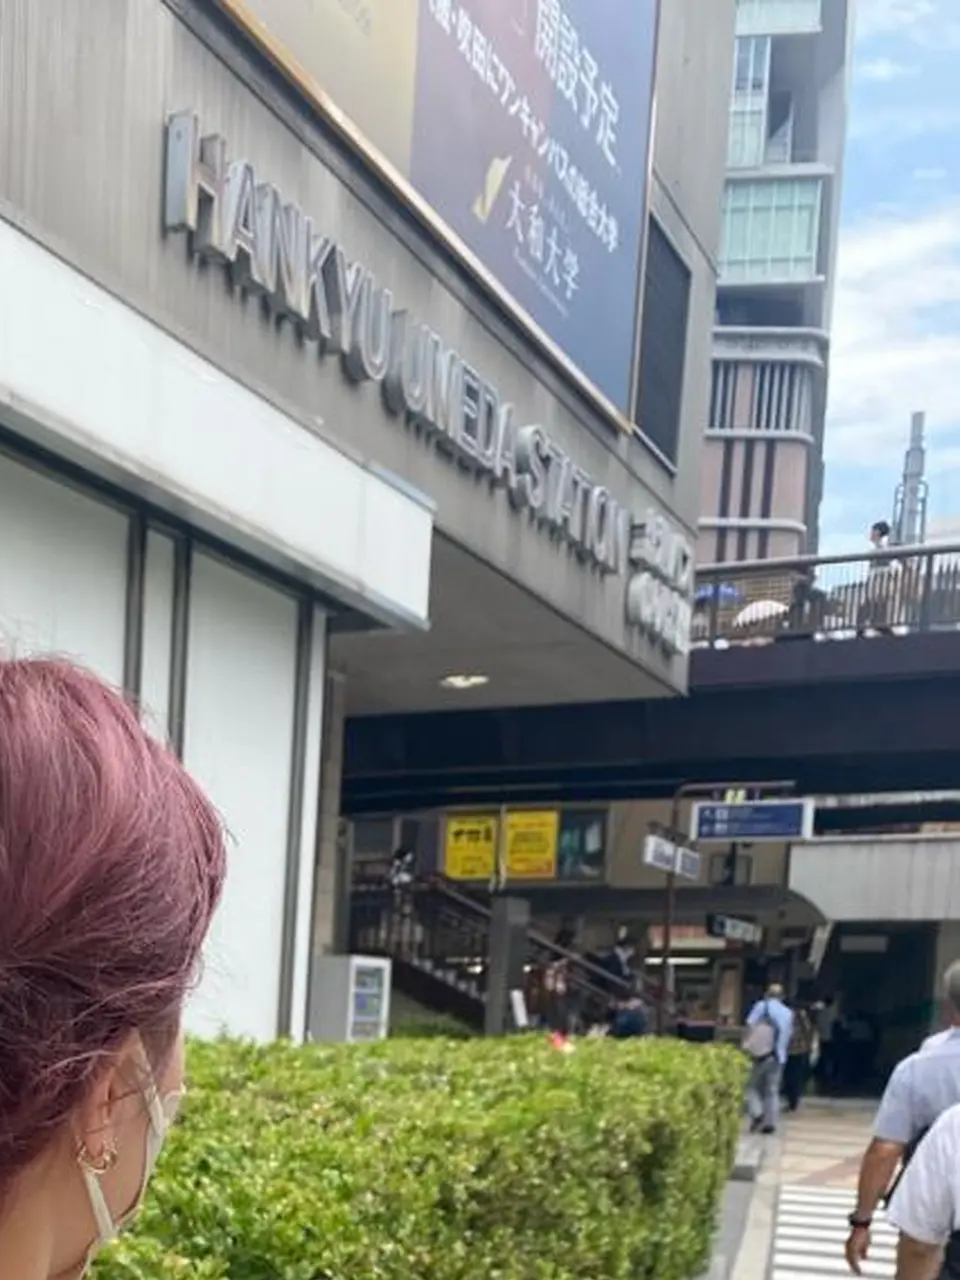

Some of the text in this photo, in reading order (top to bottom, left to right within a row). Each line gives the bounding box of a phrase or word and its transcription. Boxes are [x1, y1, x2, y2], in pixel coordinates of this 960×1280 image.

[164, 111, 393, 381] HANKYU
[384, 308, 519, 488] UMEDA
[513, 423, 630, 577] STATION
[505, 179, 580, 300] 大和大学
